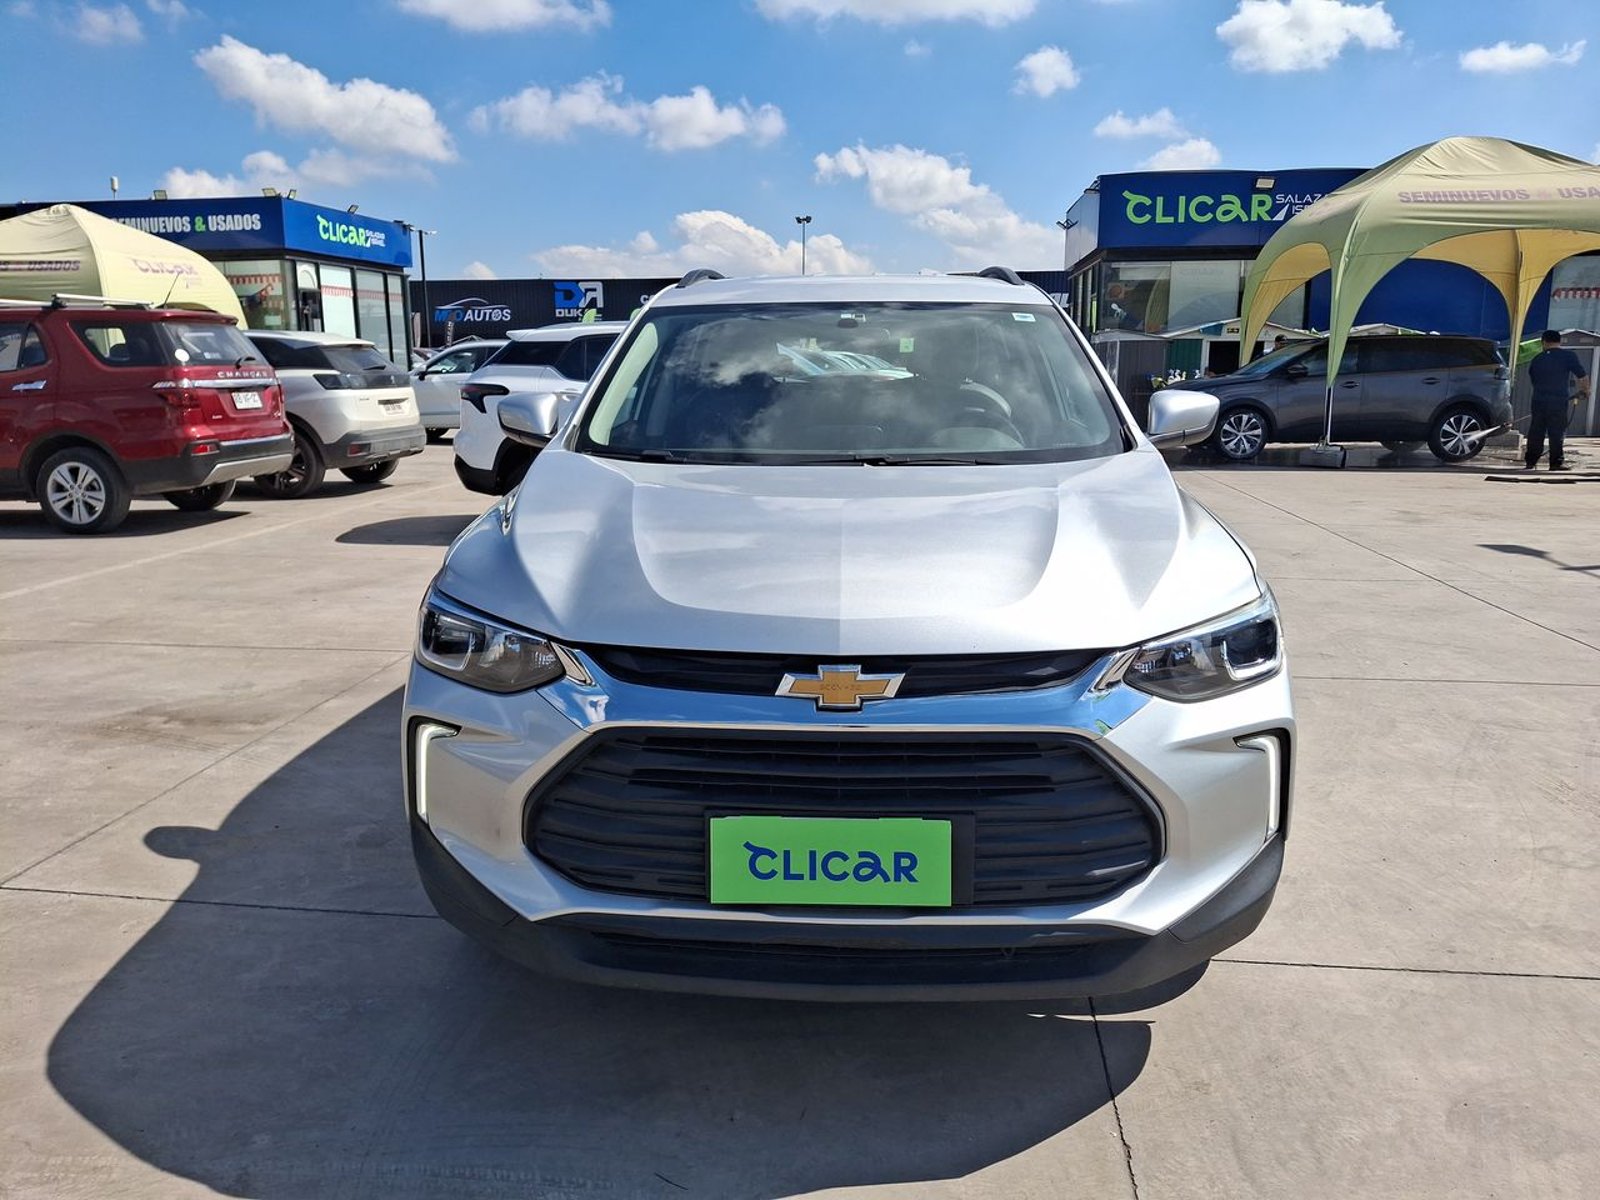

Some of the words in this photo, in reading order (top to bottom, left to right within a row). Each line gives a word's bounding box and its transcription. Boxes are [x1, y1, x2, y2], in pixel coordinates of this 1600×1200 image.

[1276, 193, 1328, 204] SALAZ
[1398, 190, 1530, 204] SEMINUEVOS
[194, 216, 206, 232] &
[208, 214, 261, 231] USADOS
